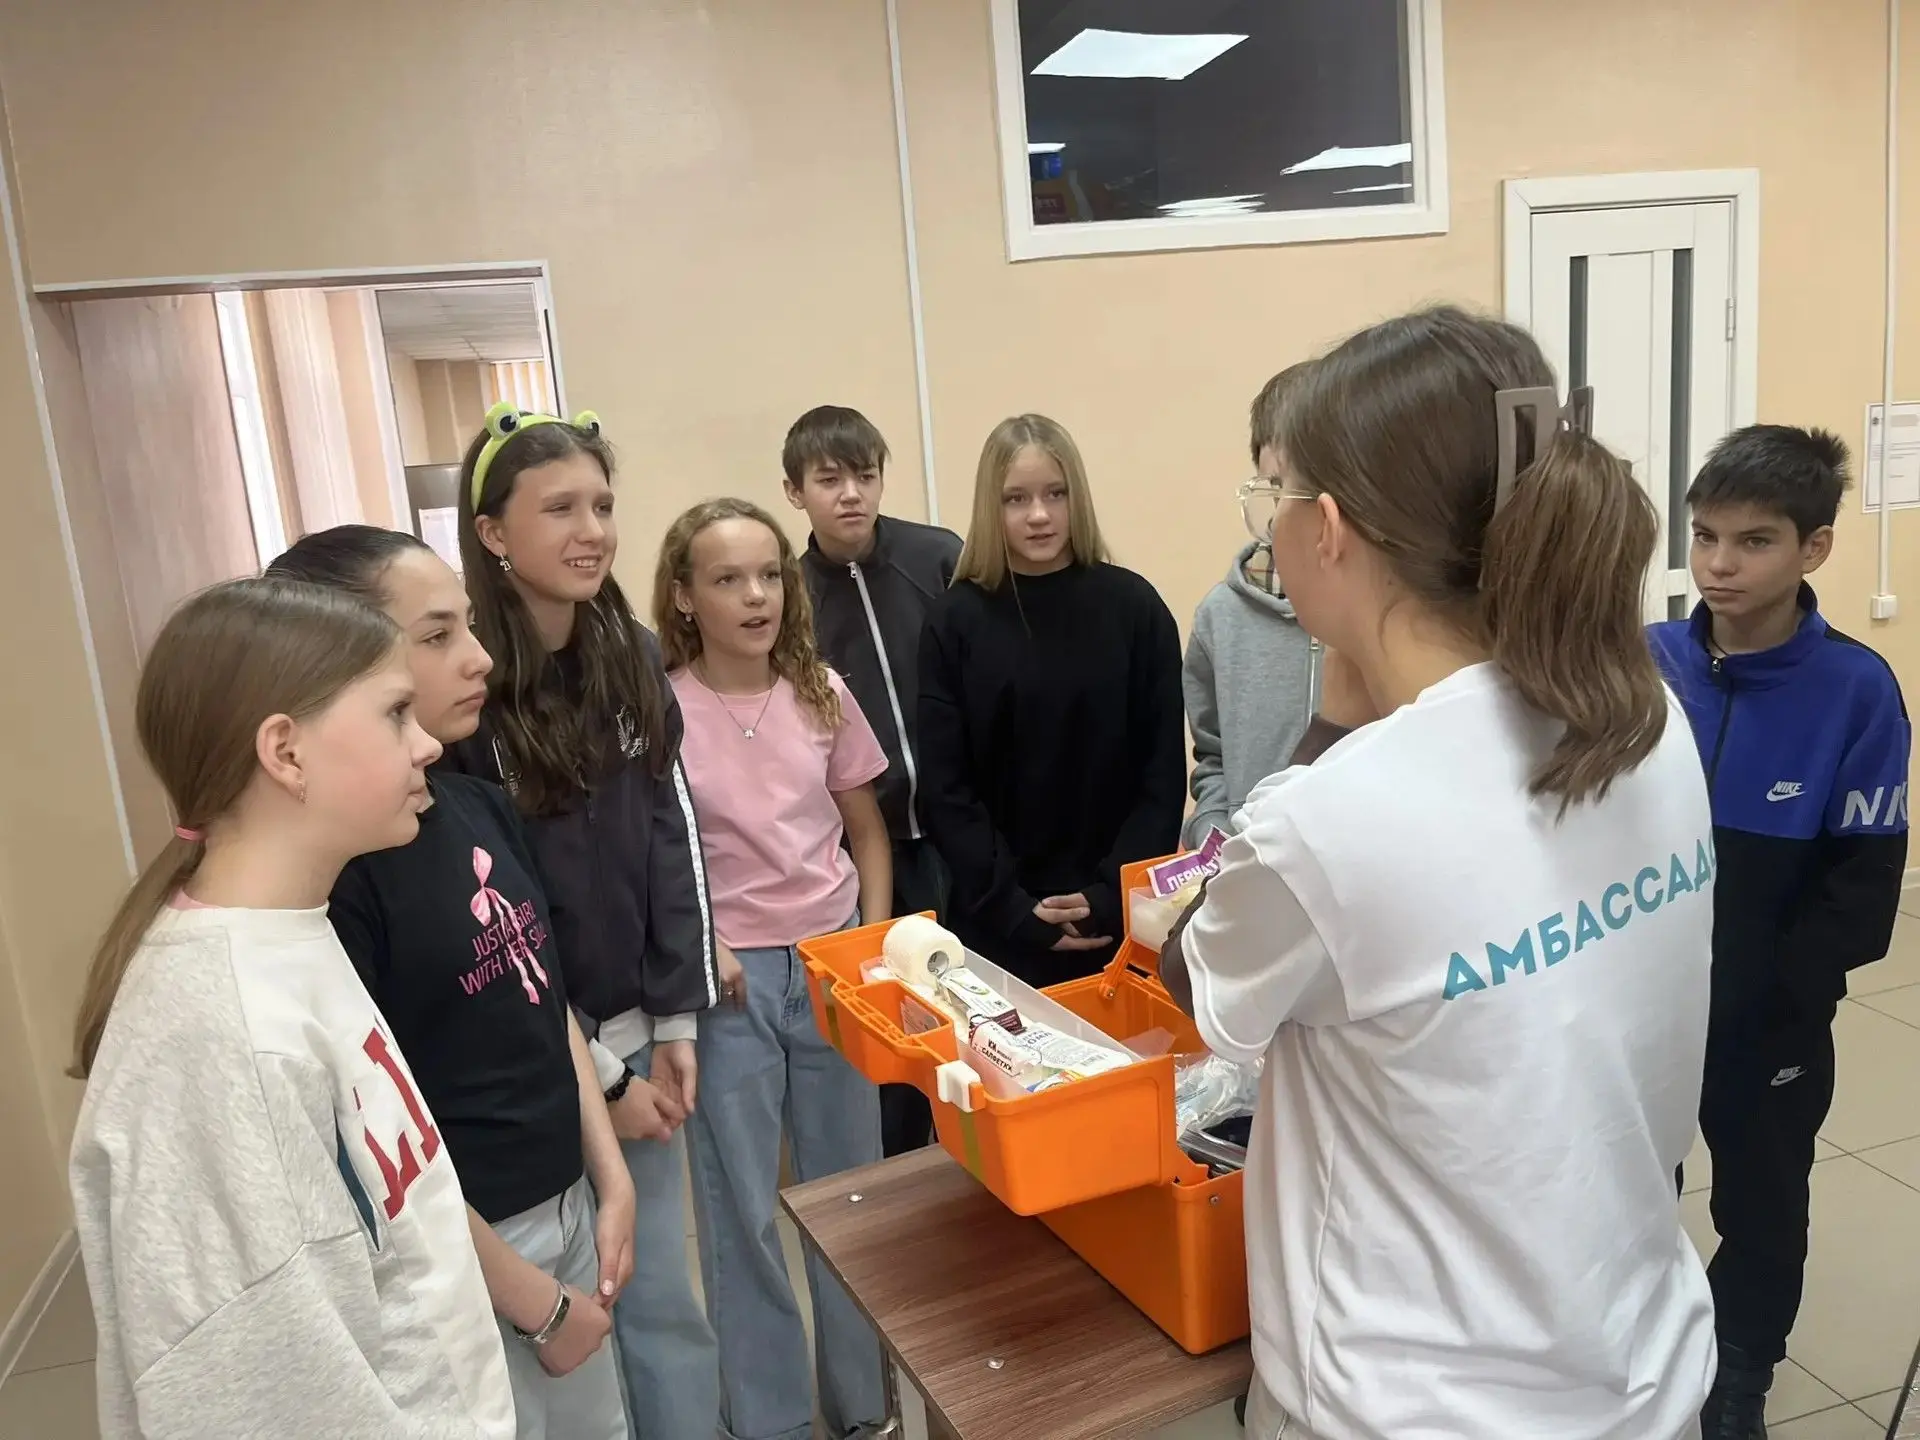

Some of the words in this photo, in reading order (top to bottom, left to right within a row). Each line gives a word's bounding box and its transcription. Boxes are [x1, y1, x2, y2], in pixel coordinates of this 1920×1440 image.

[472, 922, 504, 962] JUST
[513, 899, 536, 928] GIRL
[459, 954, 504, 995] WITH
[504, 937, 528, 971] HER
[981, 1047, 1012, 1072] САЛФЕТКИ
